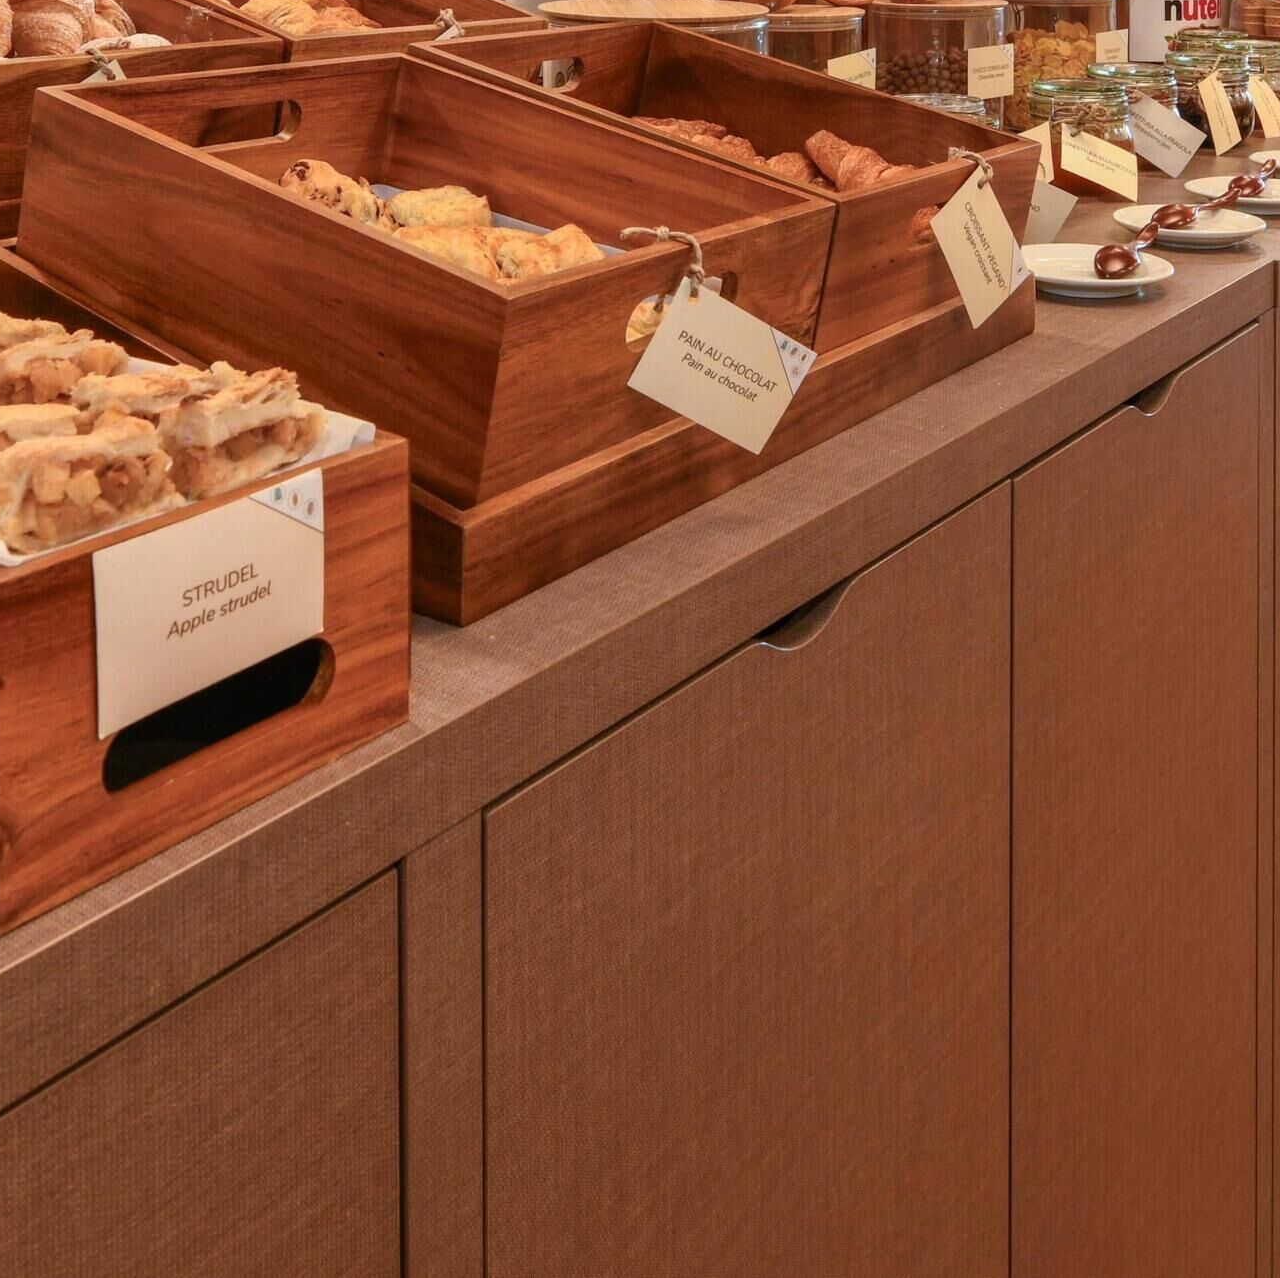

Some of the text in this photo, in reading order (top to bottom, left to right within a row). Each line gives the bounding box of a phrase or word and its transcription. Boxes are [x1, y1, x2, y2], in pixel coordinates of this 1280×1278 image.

[1134, 122, 1161, 144] Strawberry
[1167, 136, 1192, 155] FRAGOLA
[964, 201, 991, 252] CROISSANT
[963, 222, 993, 285] Vegan croissant
[678, 330, 778, 394] PAIN AU CHOCOLAT
[681, 352, 758, 403] Pain au chocolat
[166, 580, 272, 640] Apple strudel
[181, 562, 259, 608] STRUDEL
